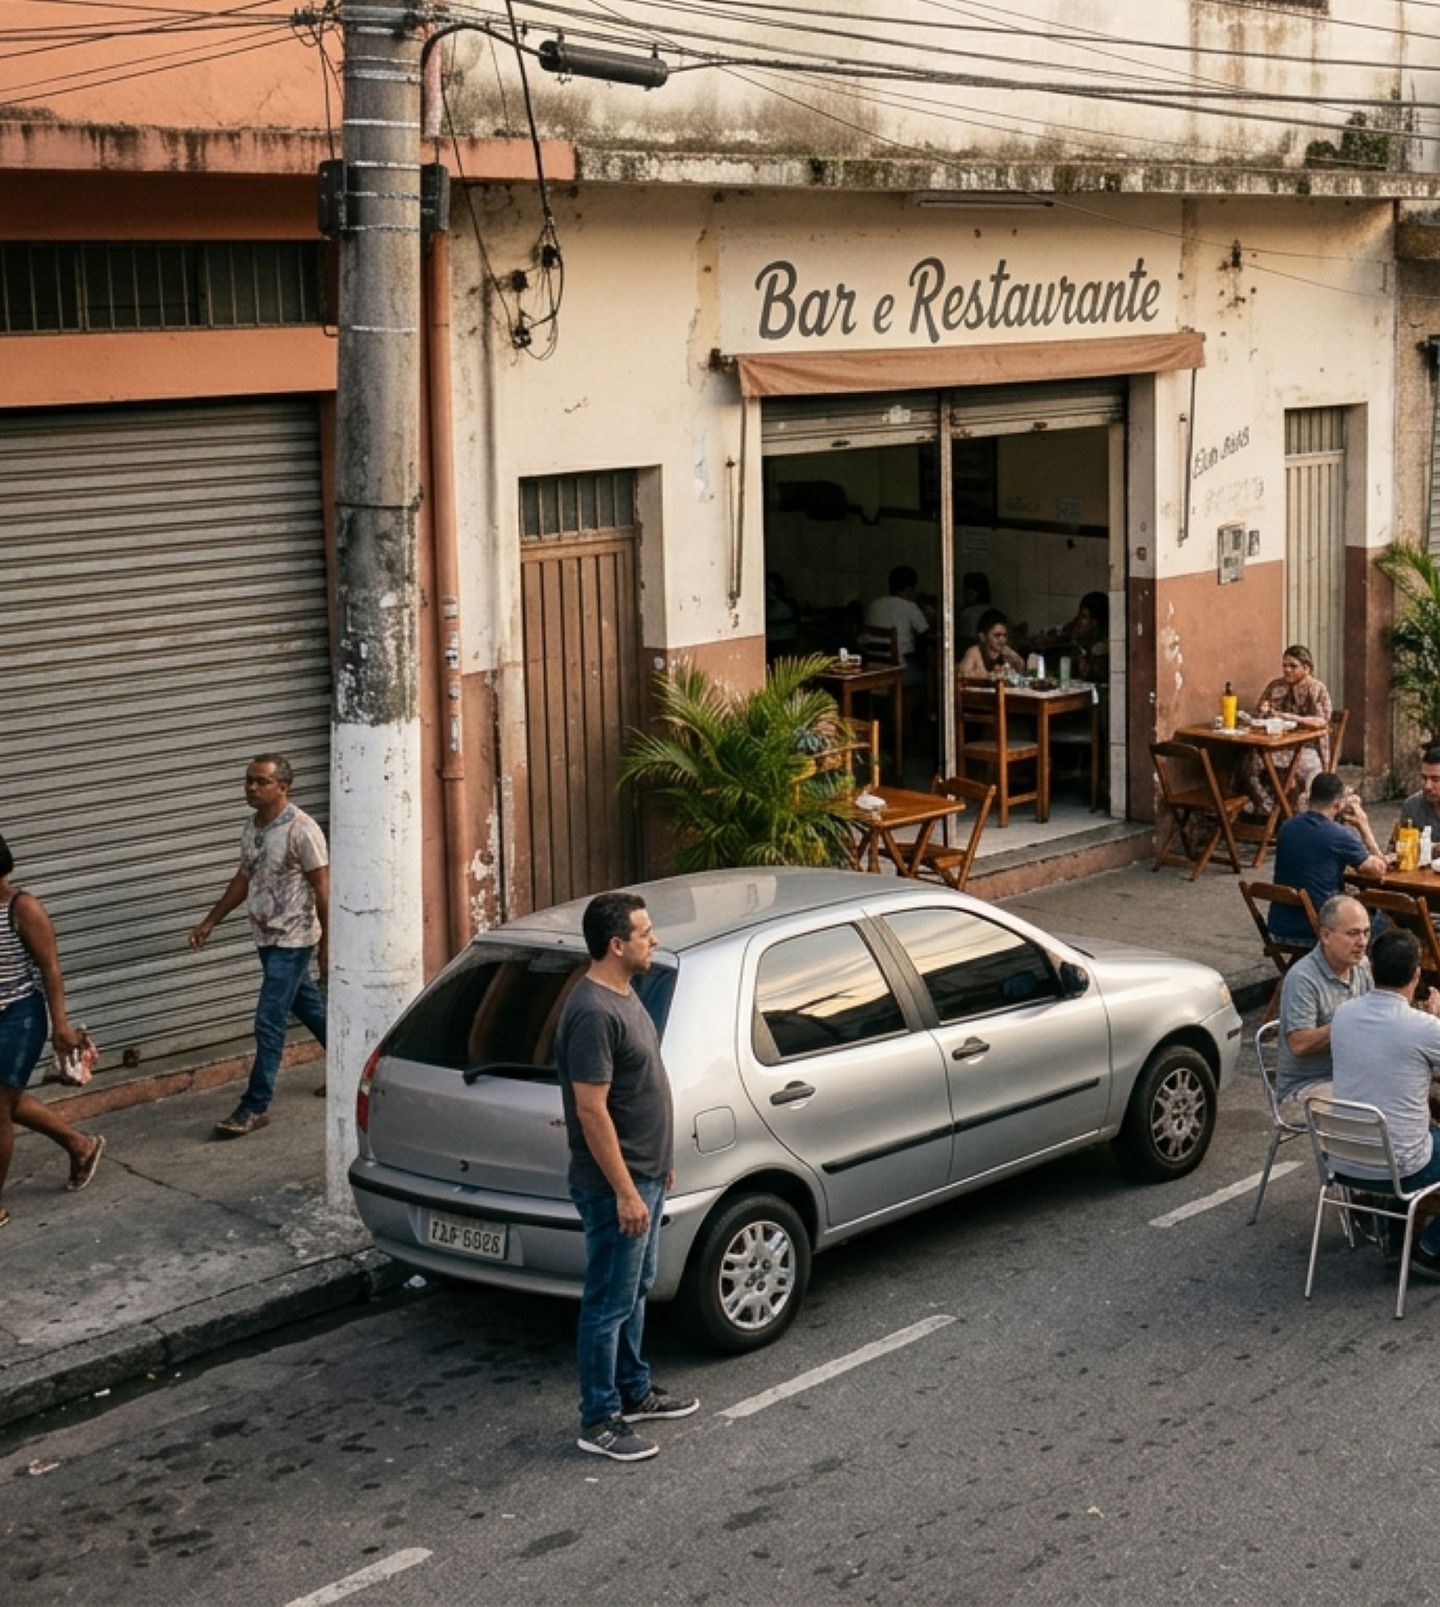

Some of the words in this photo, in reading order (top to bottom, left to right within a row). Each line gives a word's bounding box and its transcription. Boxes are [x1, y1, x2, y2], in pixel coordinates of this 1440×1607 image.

[755, 260, 857, 340] Bar
[874, 293, 895, 333] e
[908, 257, 1162, 344] Restaurante
